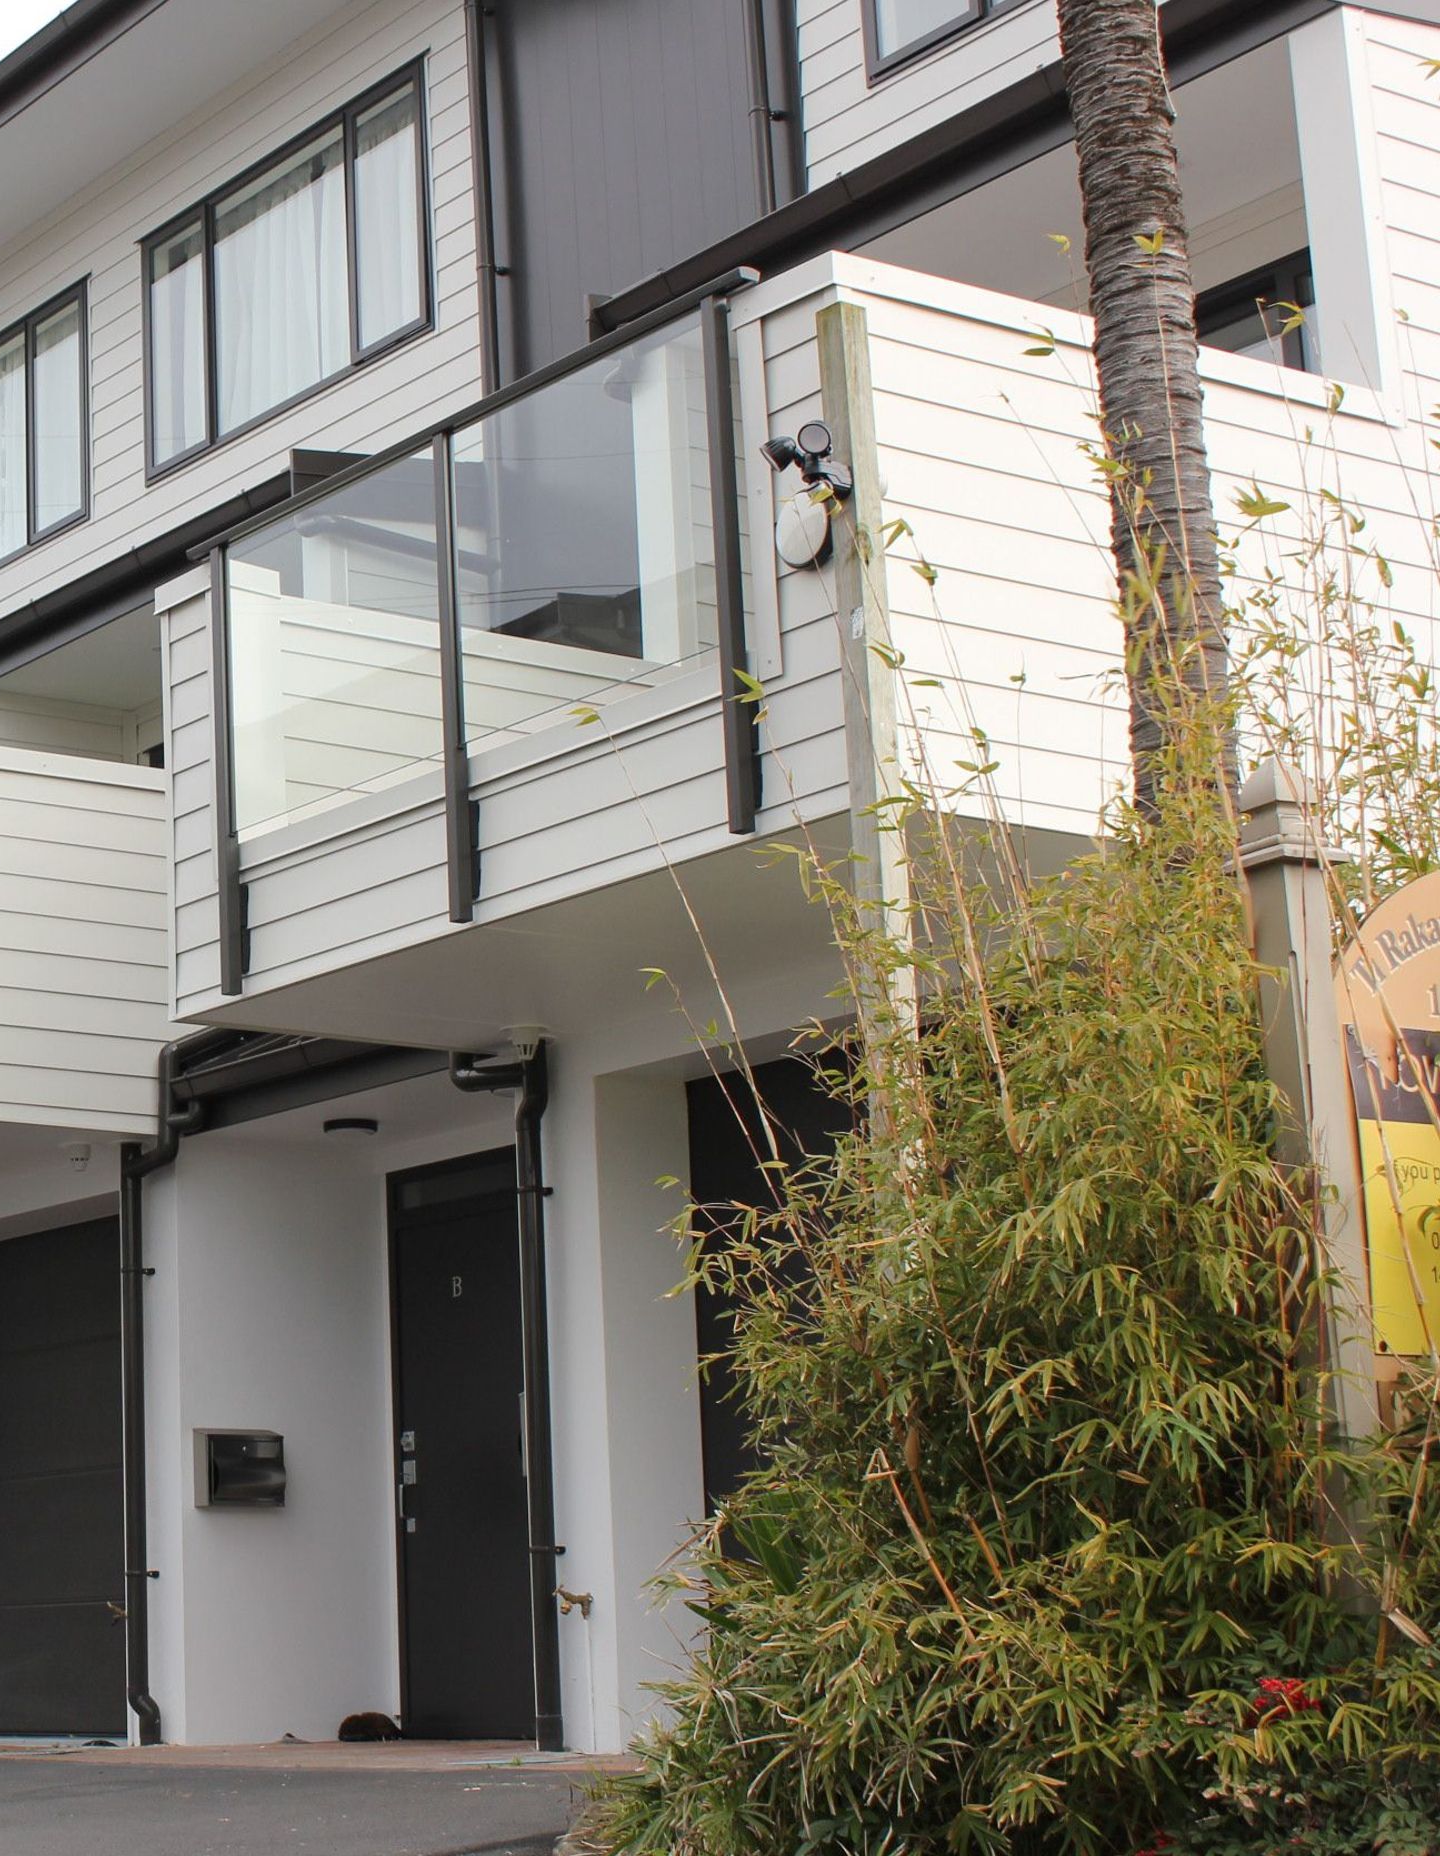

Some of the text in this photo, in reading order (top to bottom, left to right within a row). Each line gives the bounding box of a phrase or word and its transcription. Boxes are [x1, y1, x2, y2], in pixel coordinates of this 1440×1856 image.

[1375, 913, 1440, 975] Raka
[1401, 1164, 1428, 1183] you
[1431, 1265, 1440, 1283] 1
[452, 1275, 462, 1298] B
